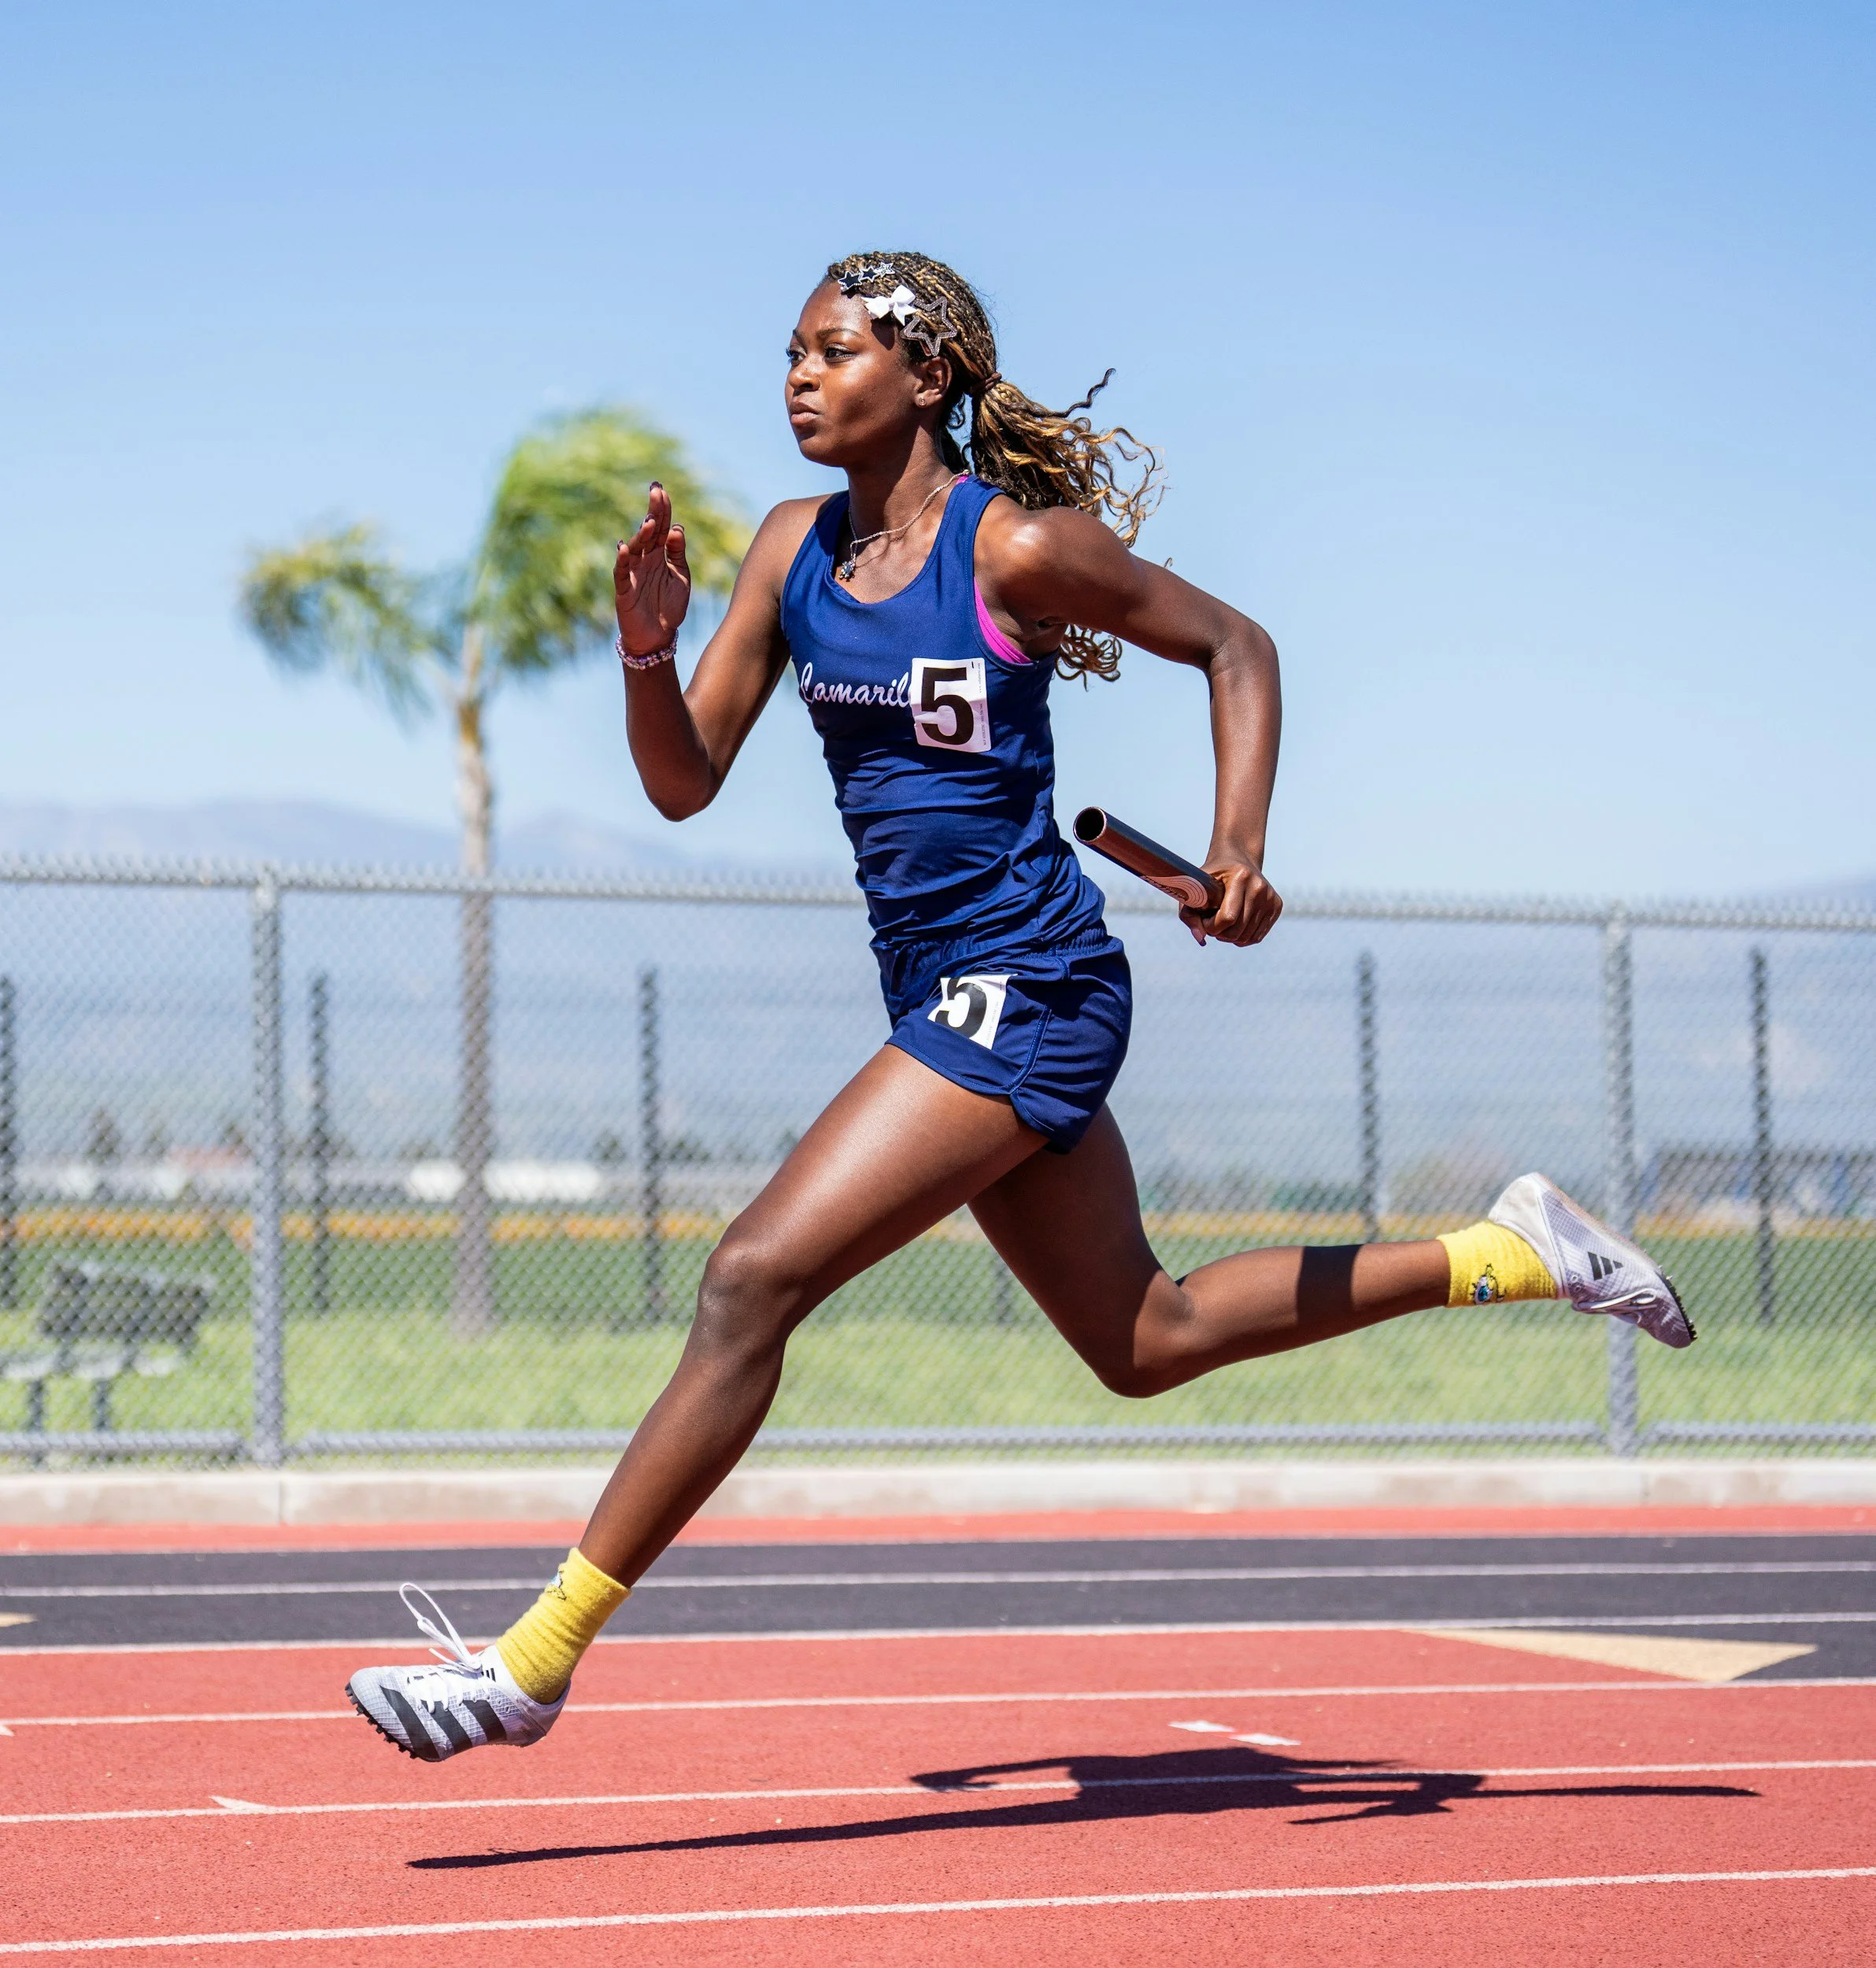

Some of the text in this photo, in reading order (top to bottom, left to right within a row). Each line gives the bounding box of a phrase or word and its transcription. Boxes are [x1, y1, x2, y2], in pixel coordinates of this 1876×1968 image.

[801, 662, 912, 708] Camaril
[921, 667, 974, 745] 5
[935, 978, 987, 1039] 5
